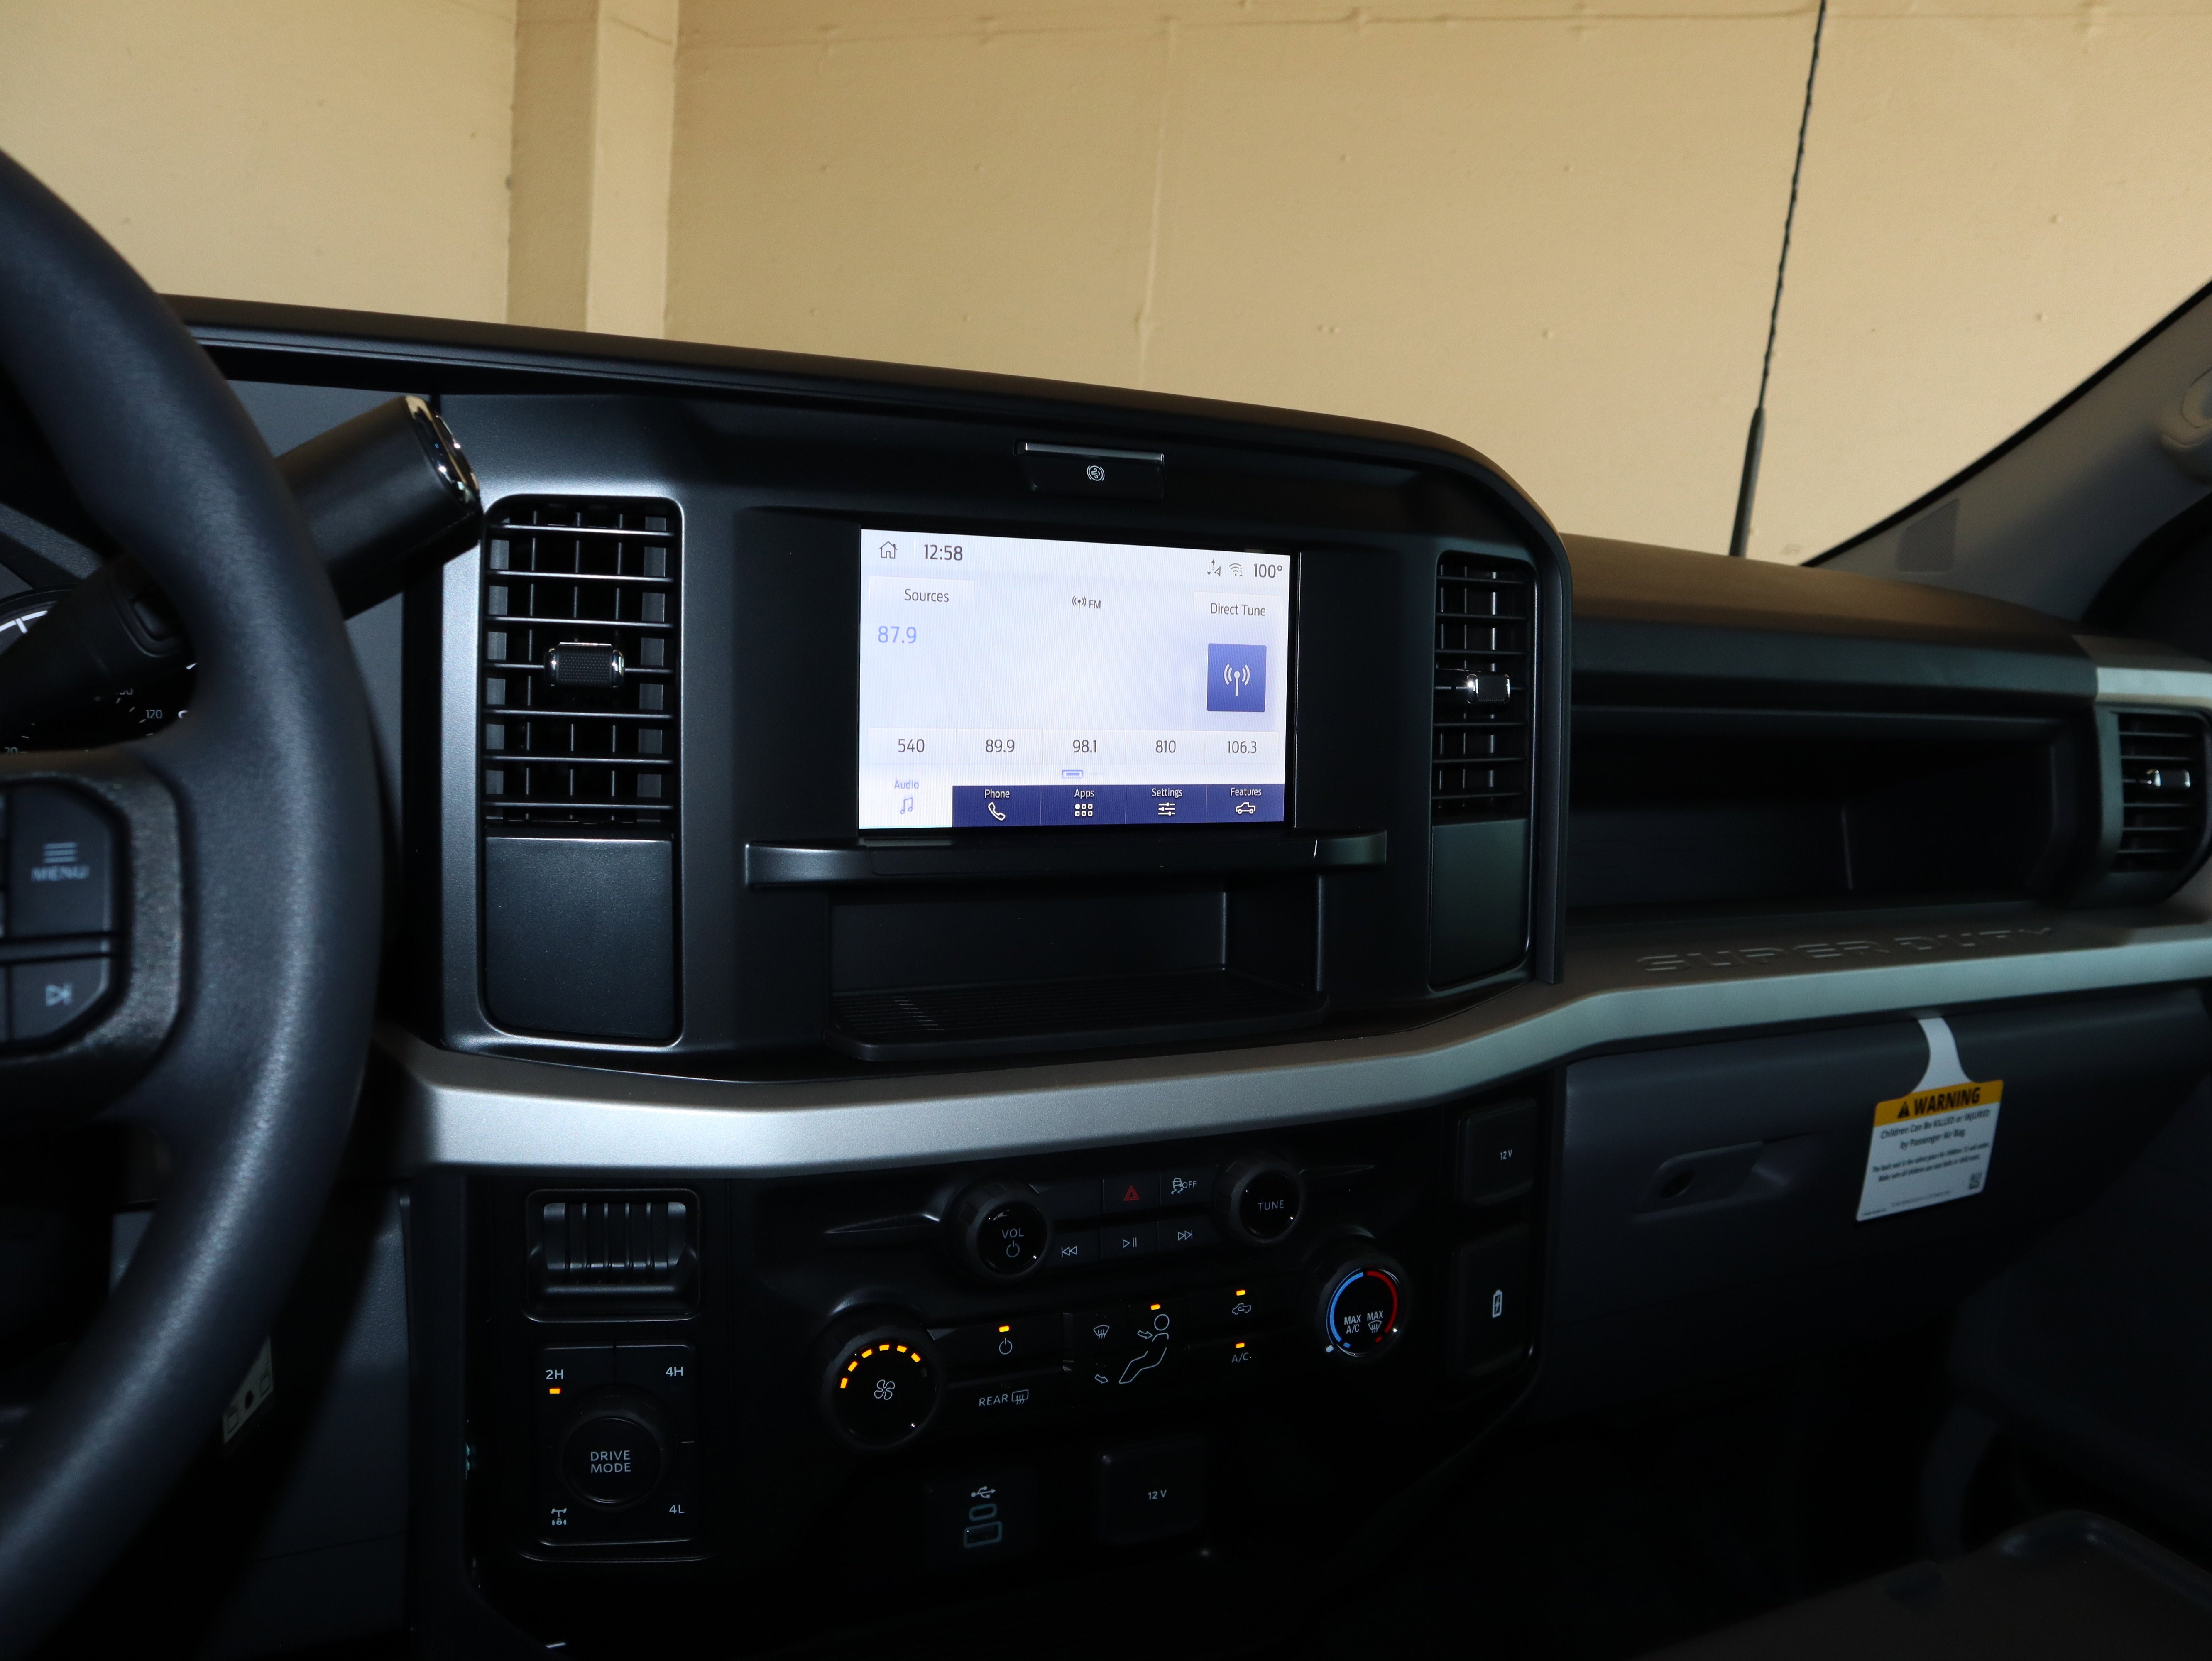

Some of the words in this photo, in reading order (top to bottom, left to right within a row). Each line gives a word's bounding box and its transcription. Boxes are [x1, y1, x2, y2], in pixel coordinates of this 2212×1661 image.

[924, 544, 963, 561] 12:58
[904, 588, 949, 602] Sources
[1089, 600, 1101, 609] FM
[1211, 603, 1238, 615] Direct
[1241, 604, 1266, 616] Tune
[877, 625, 917, 644] 87.9
[145, 709, 163, 719] 120
[898, 739, 925, 752] 540
[986, 739, 1015, 752] 89.9
[1073, 740, 1096, 753] 98.1
[1156, 740, 1176, 753] 810
[1227, 741, 1257, 754] 106.3
[894, 779, 919, 789] Audio
[984, 789, 1010, 798] Phone
[1074, 788, 1094, 799] Apps
[1151, 788, 1183, 798] Settings
[1231, 787, 1262, 796] Features
[1914, 1087, 1980, 1115] WARNING
[1182, 1180, 1197, 1189] OFF
[1257, 1200, 1284, 1211] TUNE
[1001, 1227, 1024, 1239] VOL
[1344, 1314, 1362, 1325] MAX
[1367, 1310, 1384, 1322] MAX
[1346, 1323, 1360, 1335] A/C
[1231, 1352, 1249, 1363] A/C
[546, 1369, 564, 1380] 2H
[665, 1366, 683, 1377] 4H
[979, 1394, 1008, 1407] REAR
[590, 1450, 631, 1461] DRIVE
[591, 1462, 631, 1473] MODE
[1148, 1491, 1158, 1500] 12
[669, 1504, 685, 1514] 4L
